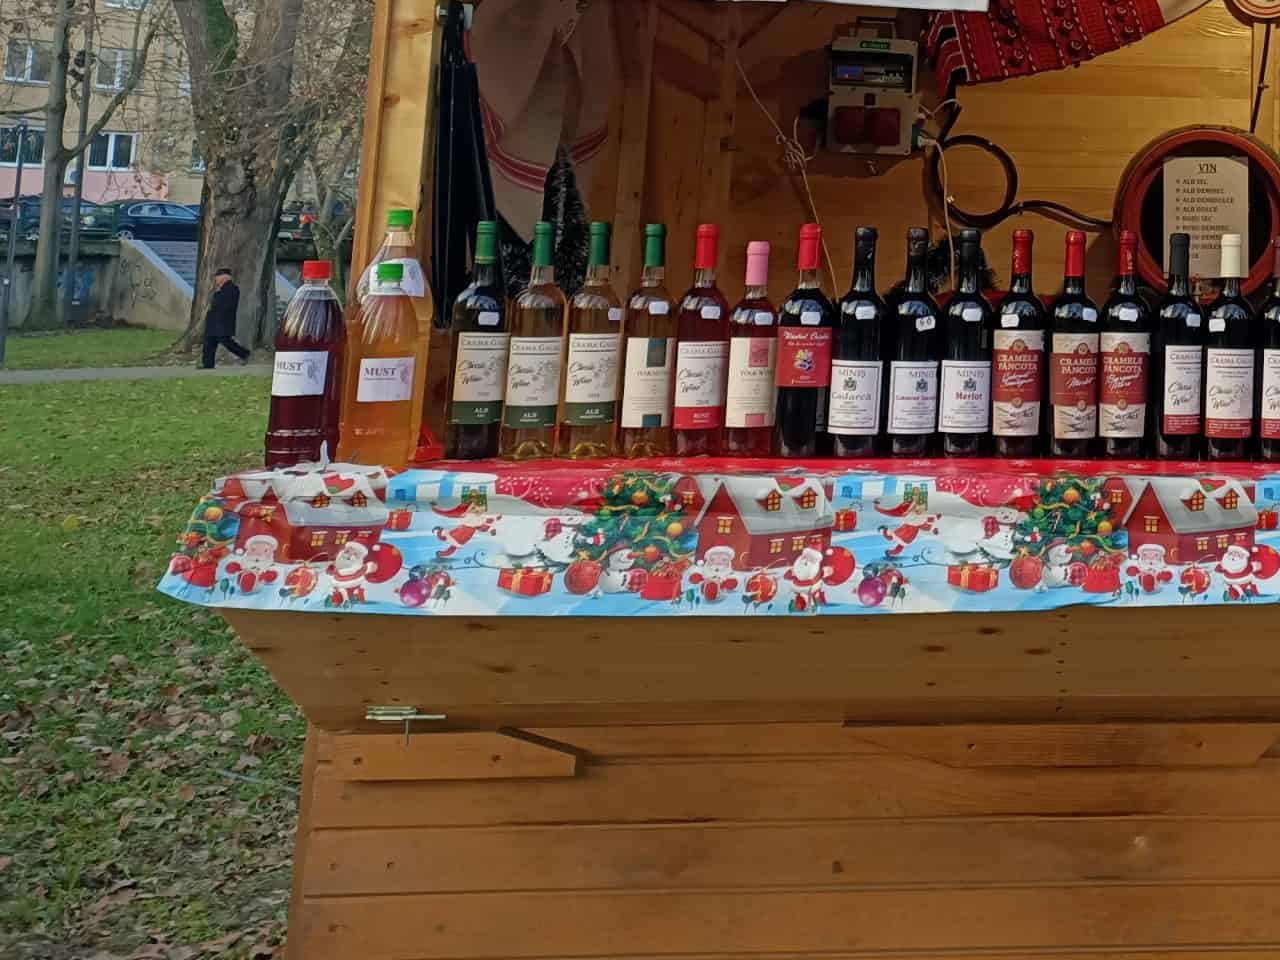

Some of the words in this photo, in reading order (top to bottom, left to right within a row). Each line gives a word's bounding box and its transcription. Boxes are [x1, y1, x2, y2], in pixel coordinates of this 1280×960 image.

[1198, 163, 1217, 173] VIN
[363, 367, 397, 377] MUST
[955, 391, 983, 401] Merlot
